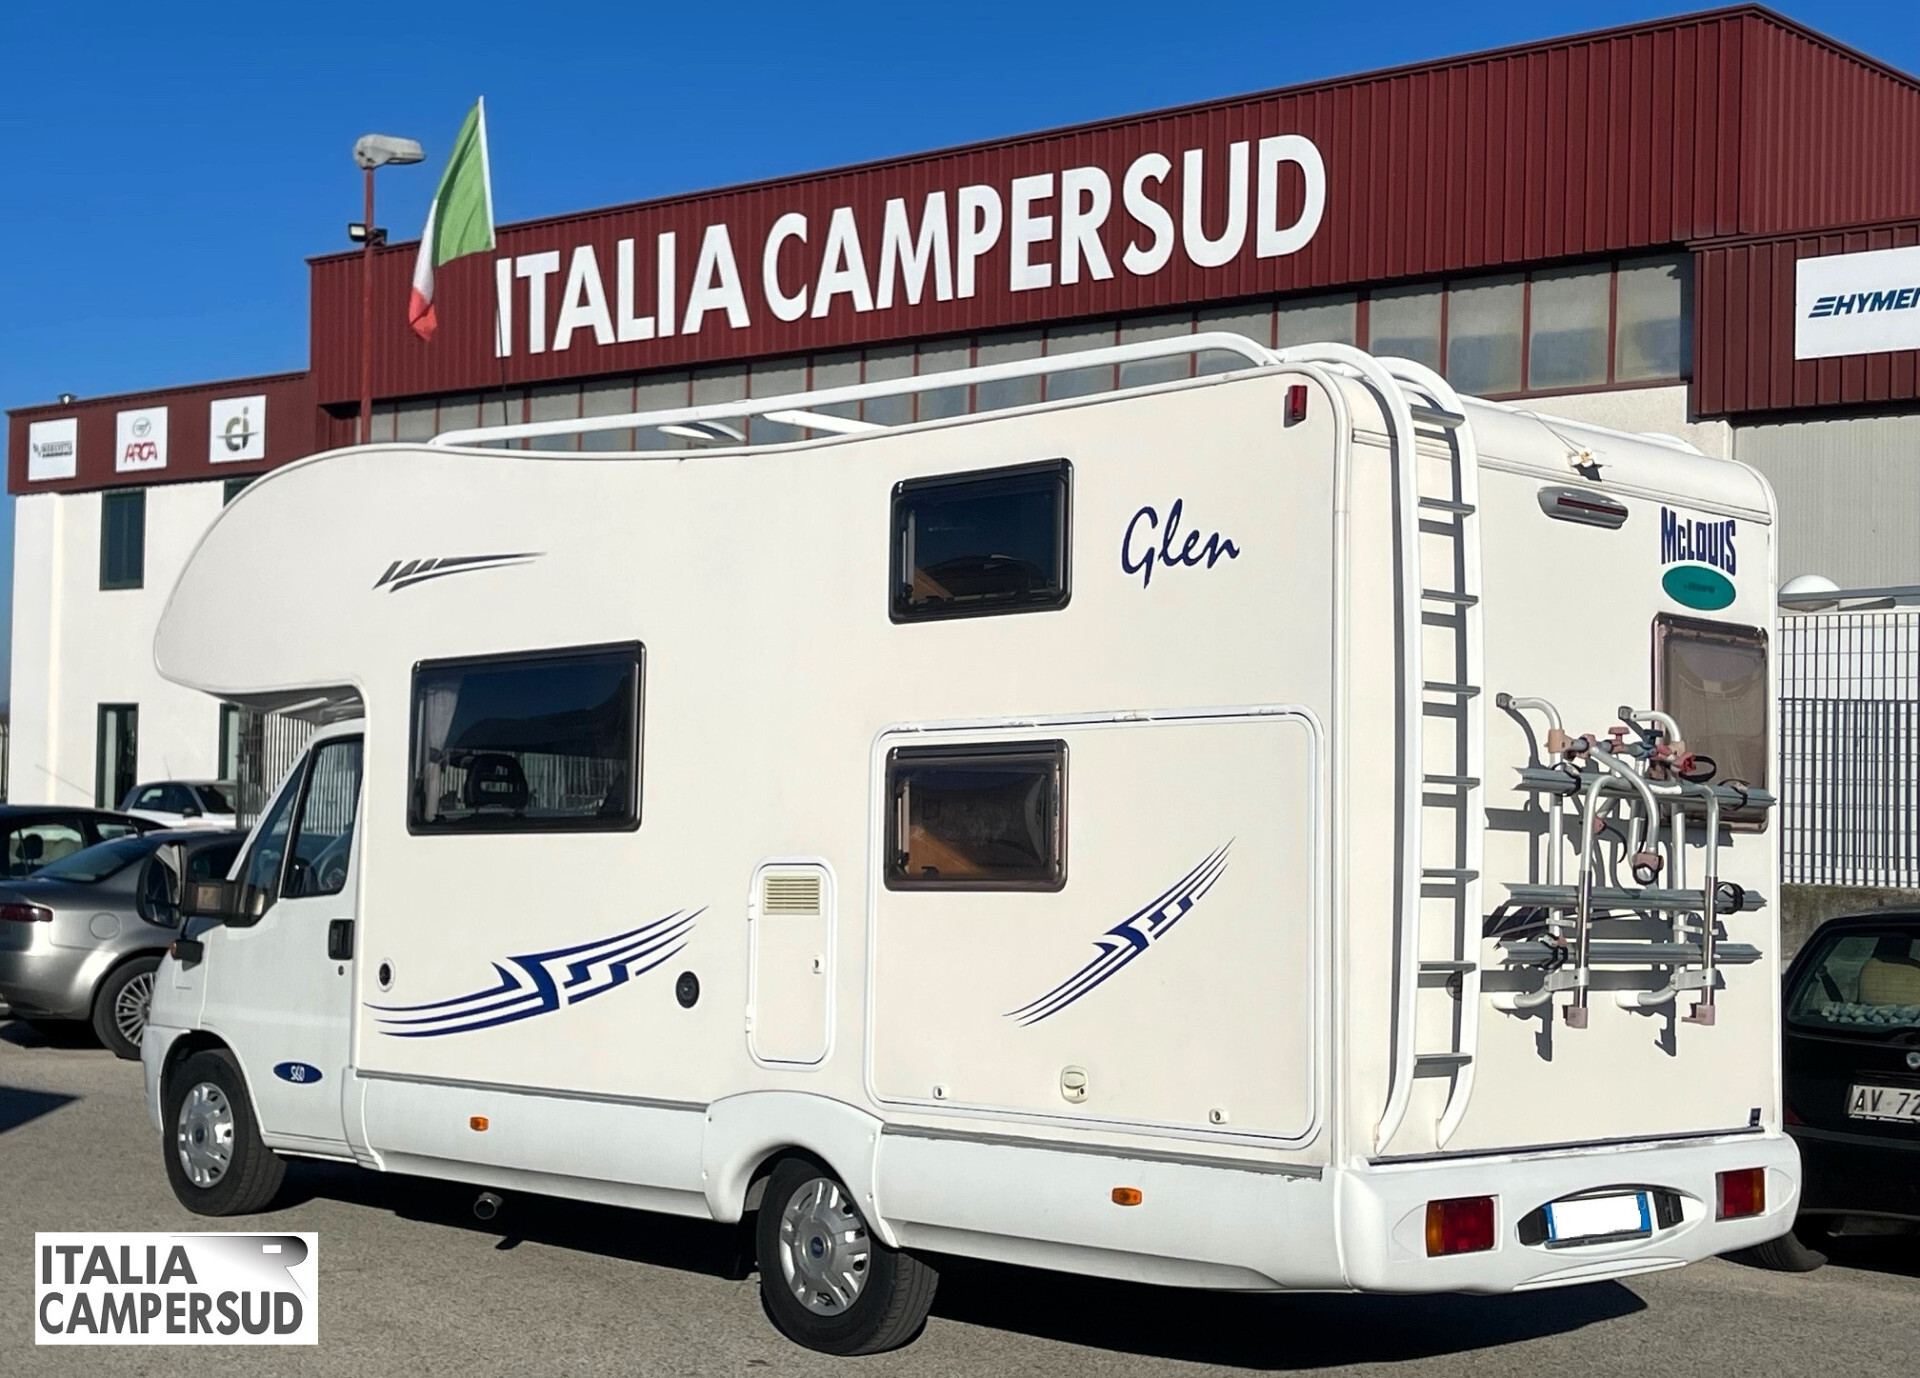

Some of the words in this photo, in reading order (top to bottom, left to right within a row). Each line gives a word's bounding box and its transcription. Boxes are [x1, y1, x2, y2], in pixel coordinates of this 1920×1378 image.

[495, 224, 750, 359] ITALIA
[762, 134, 1327, 322] CAMPERSUD
[124, 441, 158, 464] ARCA
[1121, 498, 1241, 590] Glen
[1854, 1089, 1884, 1112] AV
